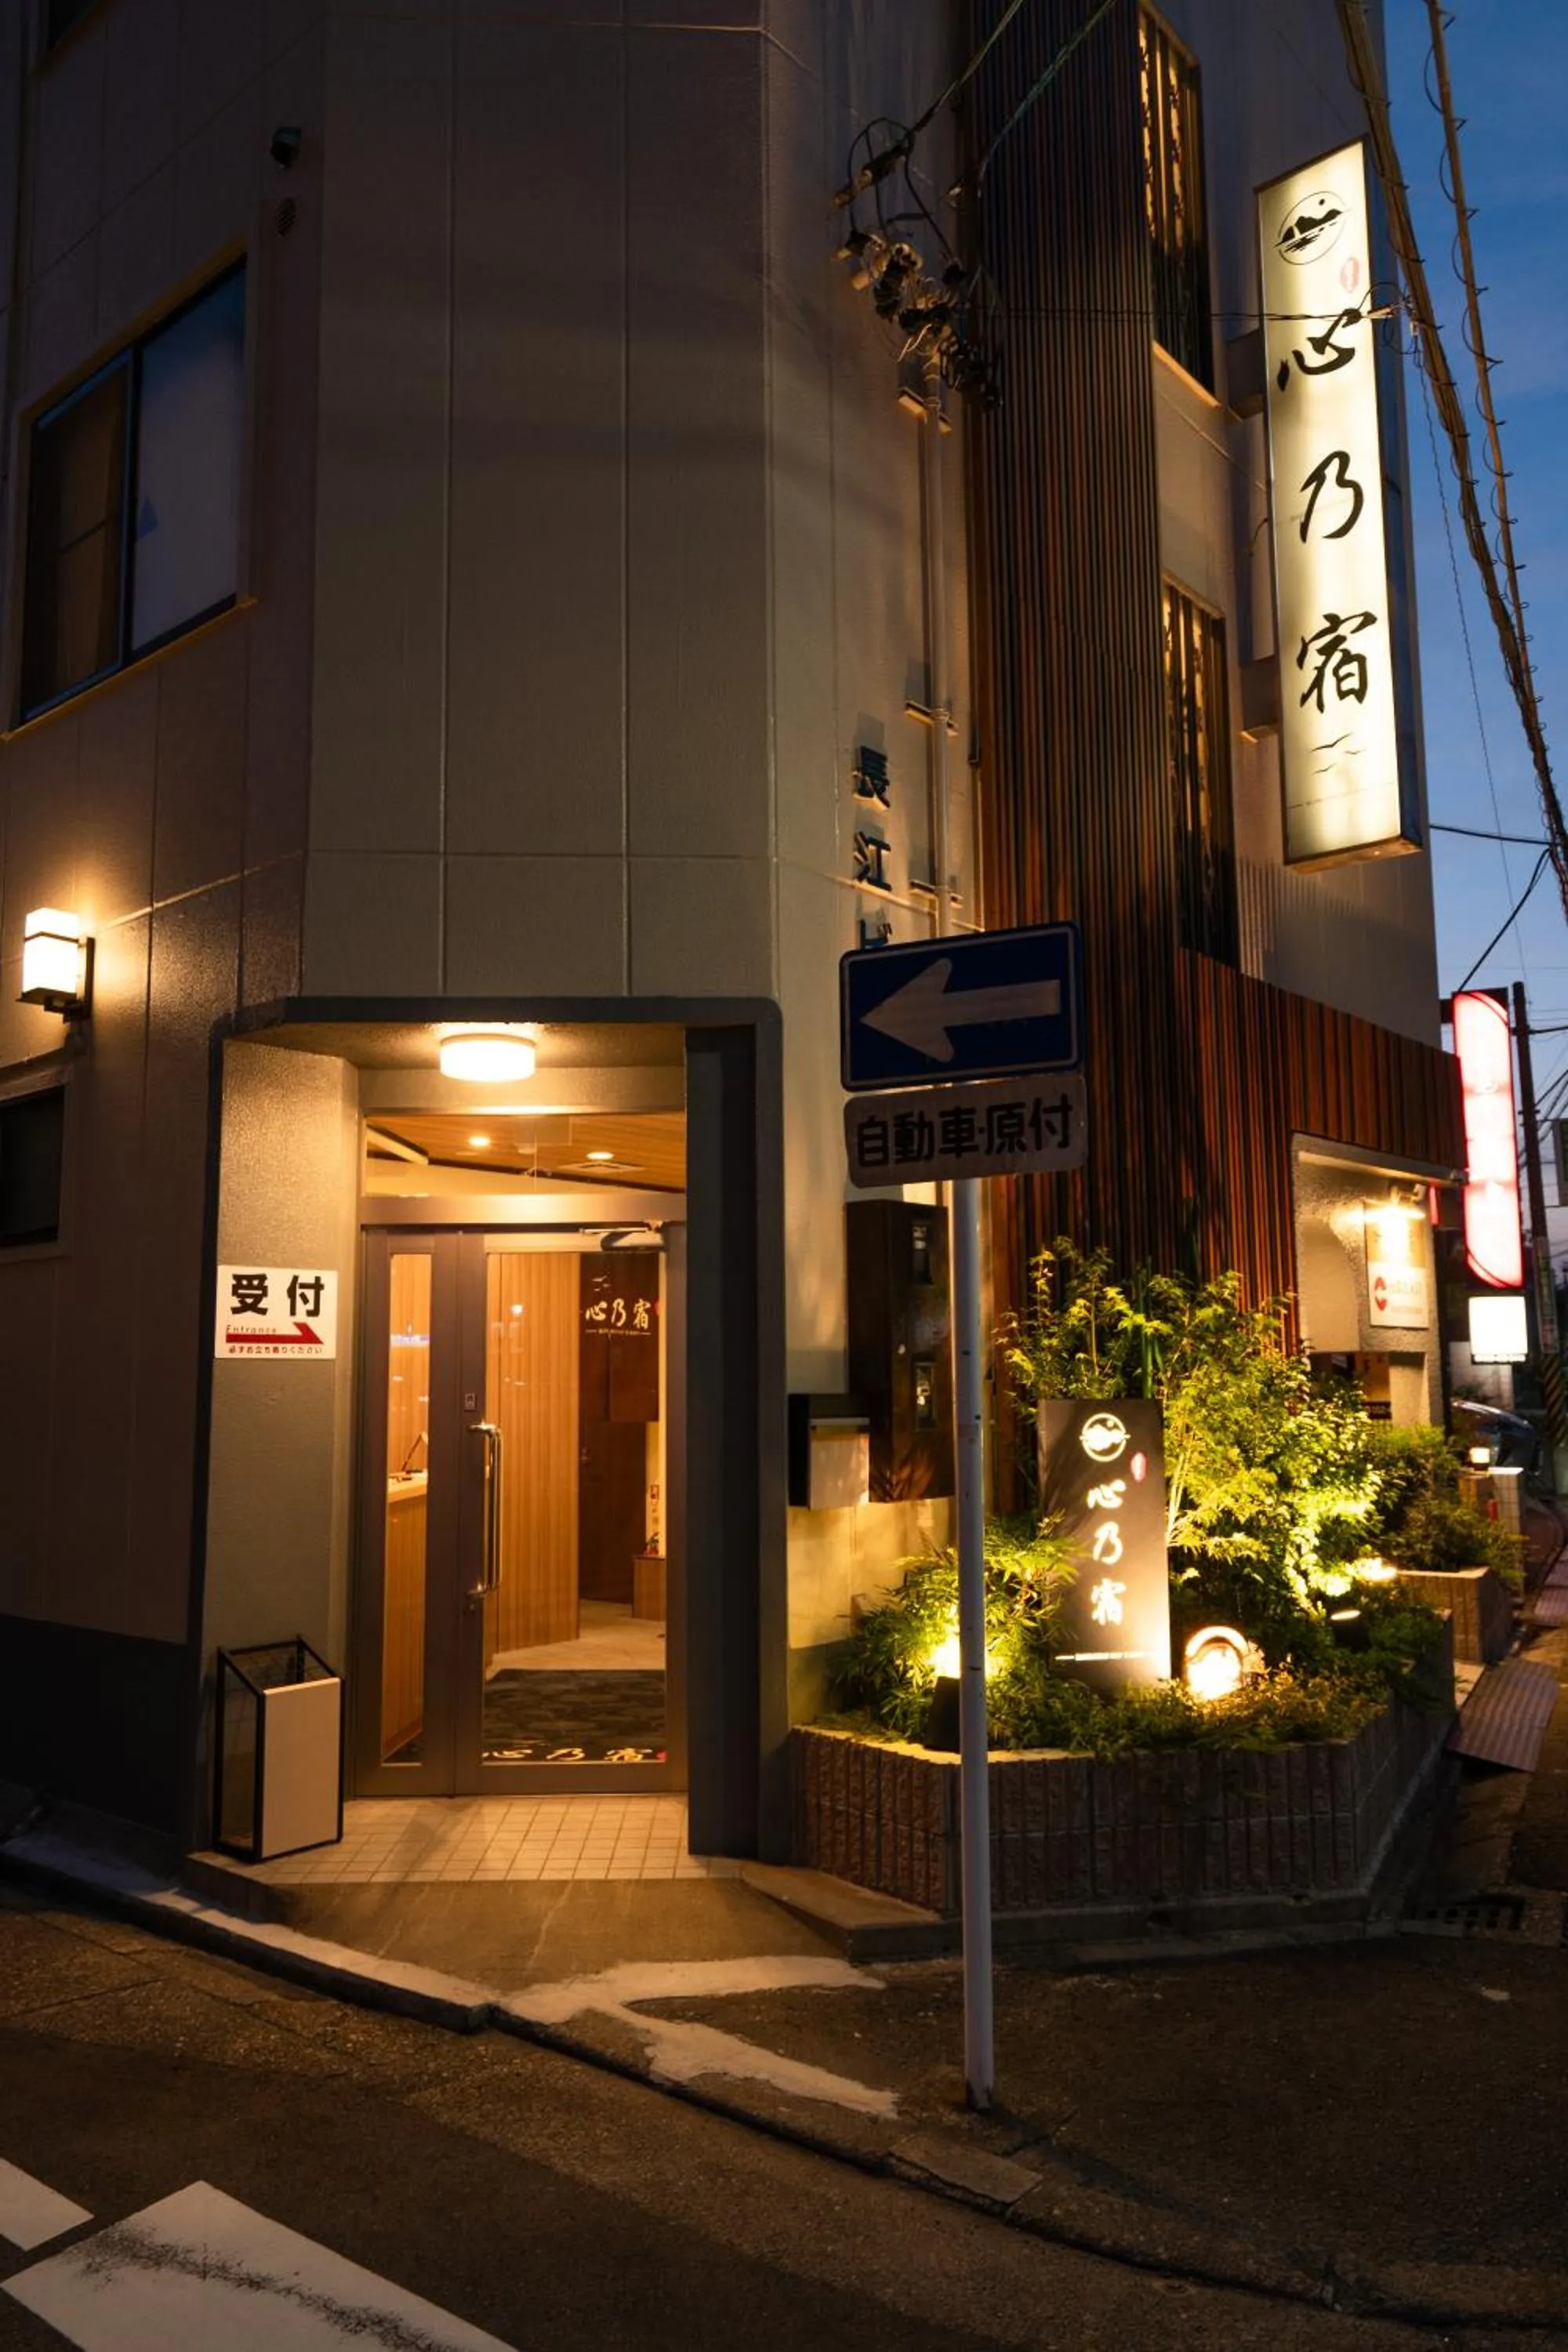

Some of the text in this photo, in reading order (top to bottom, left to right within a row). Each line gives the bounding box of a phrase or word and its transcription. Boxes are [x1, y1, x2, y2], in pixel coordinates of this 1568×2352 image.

[1276, 308, 1377, 713] 心乃宿
[230, 1274, 325, 1317] 受付
[585, 1298, 652, 1330] 心乃宿
[226, 1325, 277, 1334] Entrance
[1087, 1479, 1127, 1626] 心乃宿
